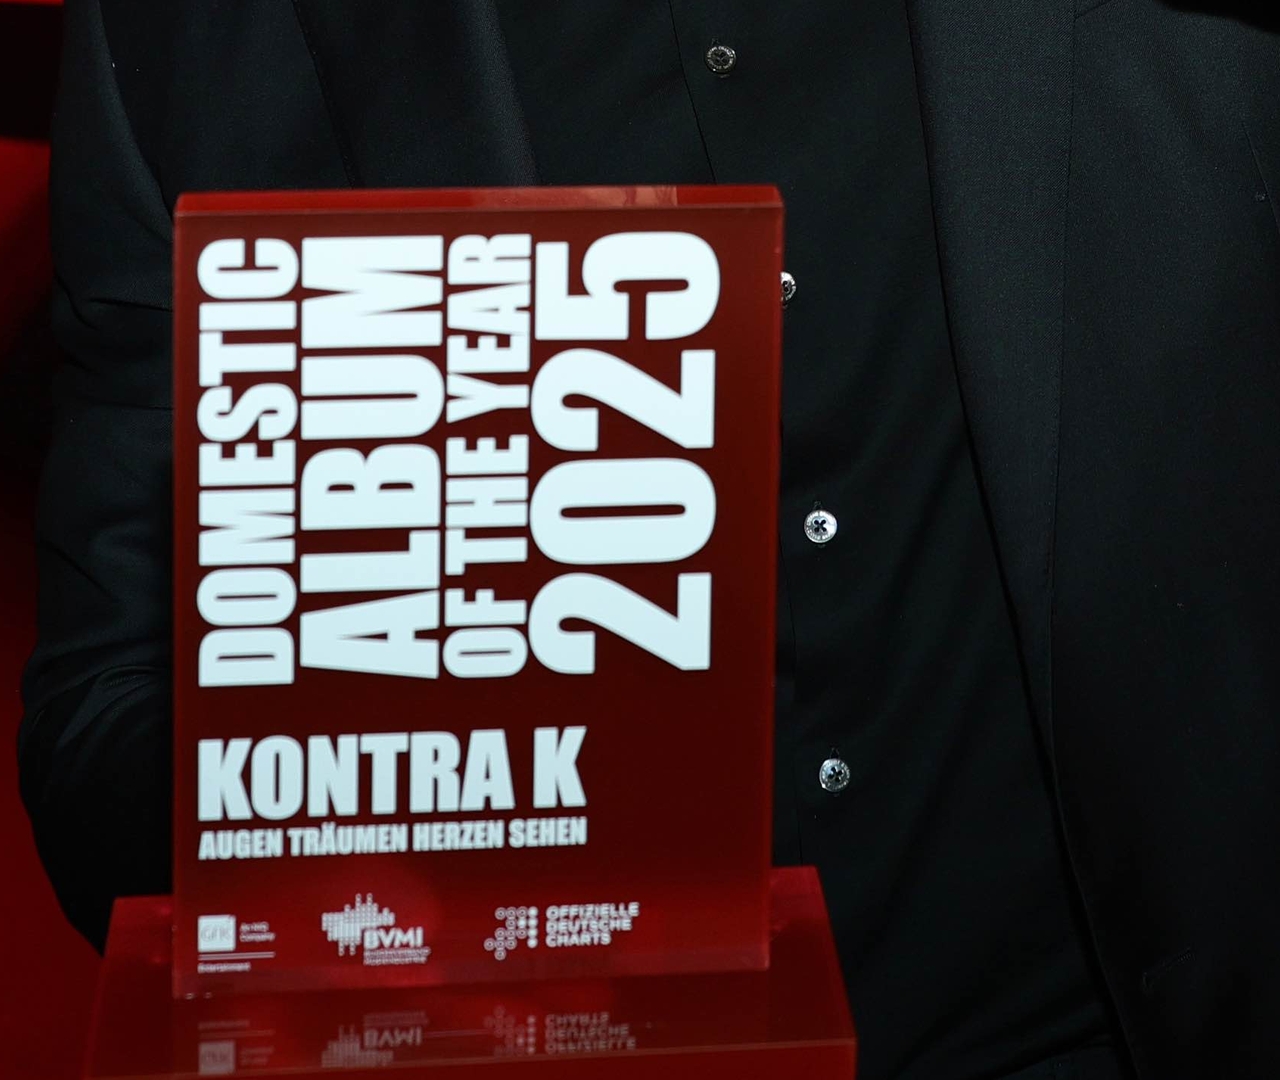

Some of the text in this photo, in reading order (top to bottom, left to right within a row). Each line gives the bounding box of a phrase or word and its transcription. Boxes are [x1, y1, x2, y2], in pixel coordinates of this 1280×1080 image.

[197, 237, 299, 687] DOMESTIC
[300, 234, 445, 679] ALBUM
[442, 233, 532, 678] OF THE YEAR
[528, 231, 720, 675] 2025
[198, 726, 587, 822] KONTRA K
[198, 816, 587, 860] AUGEN TRÄUMEN HERZEN SEHEN
[364, 926, 424, 949] BVMI
[545, 932, 611, 947] CHARTS
[546, 902, 639, 920] OFFIZIELLE
[546, 917, 632, 933] DEUTSCHE
